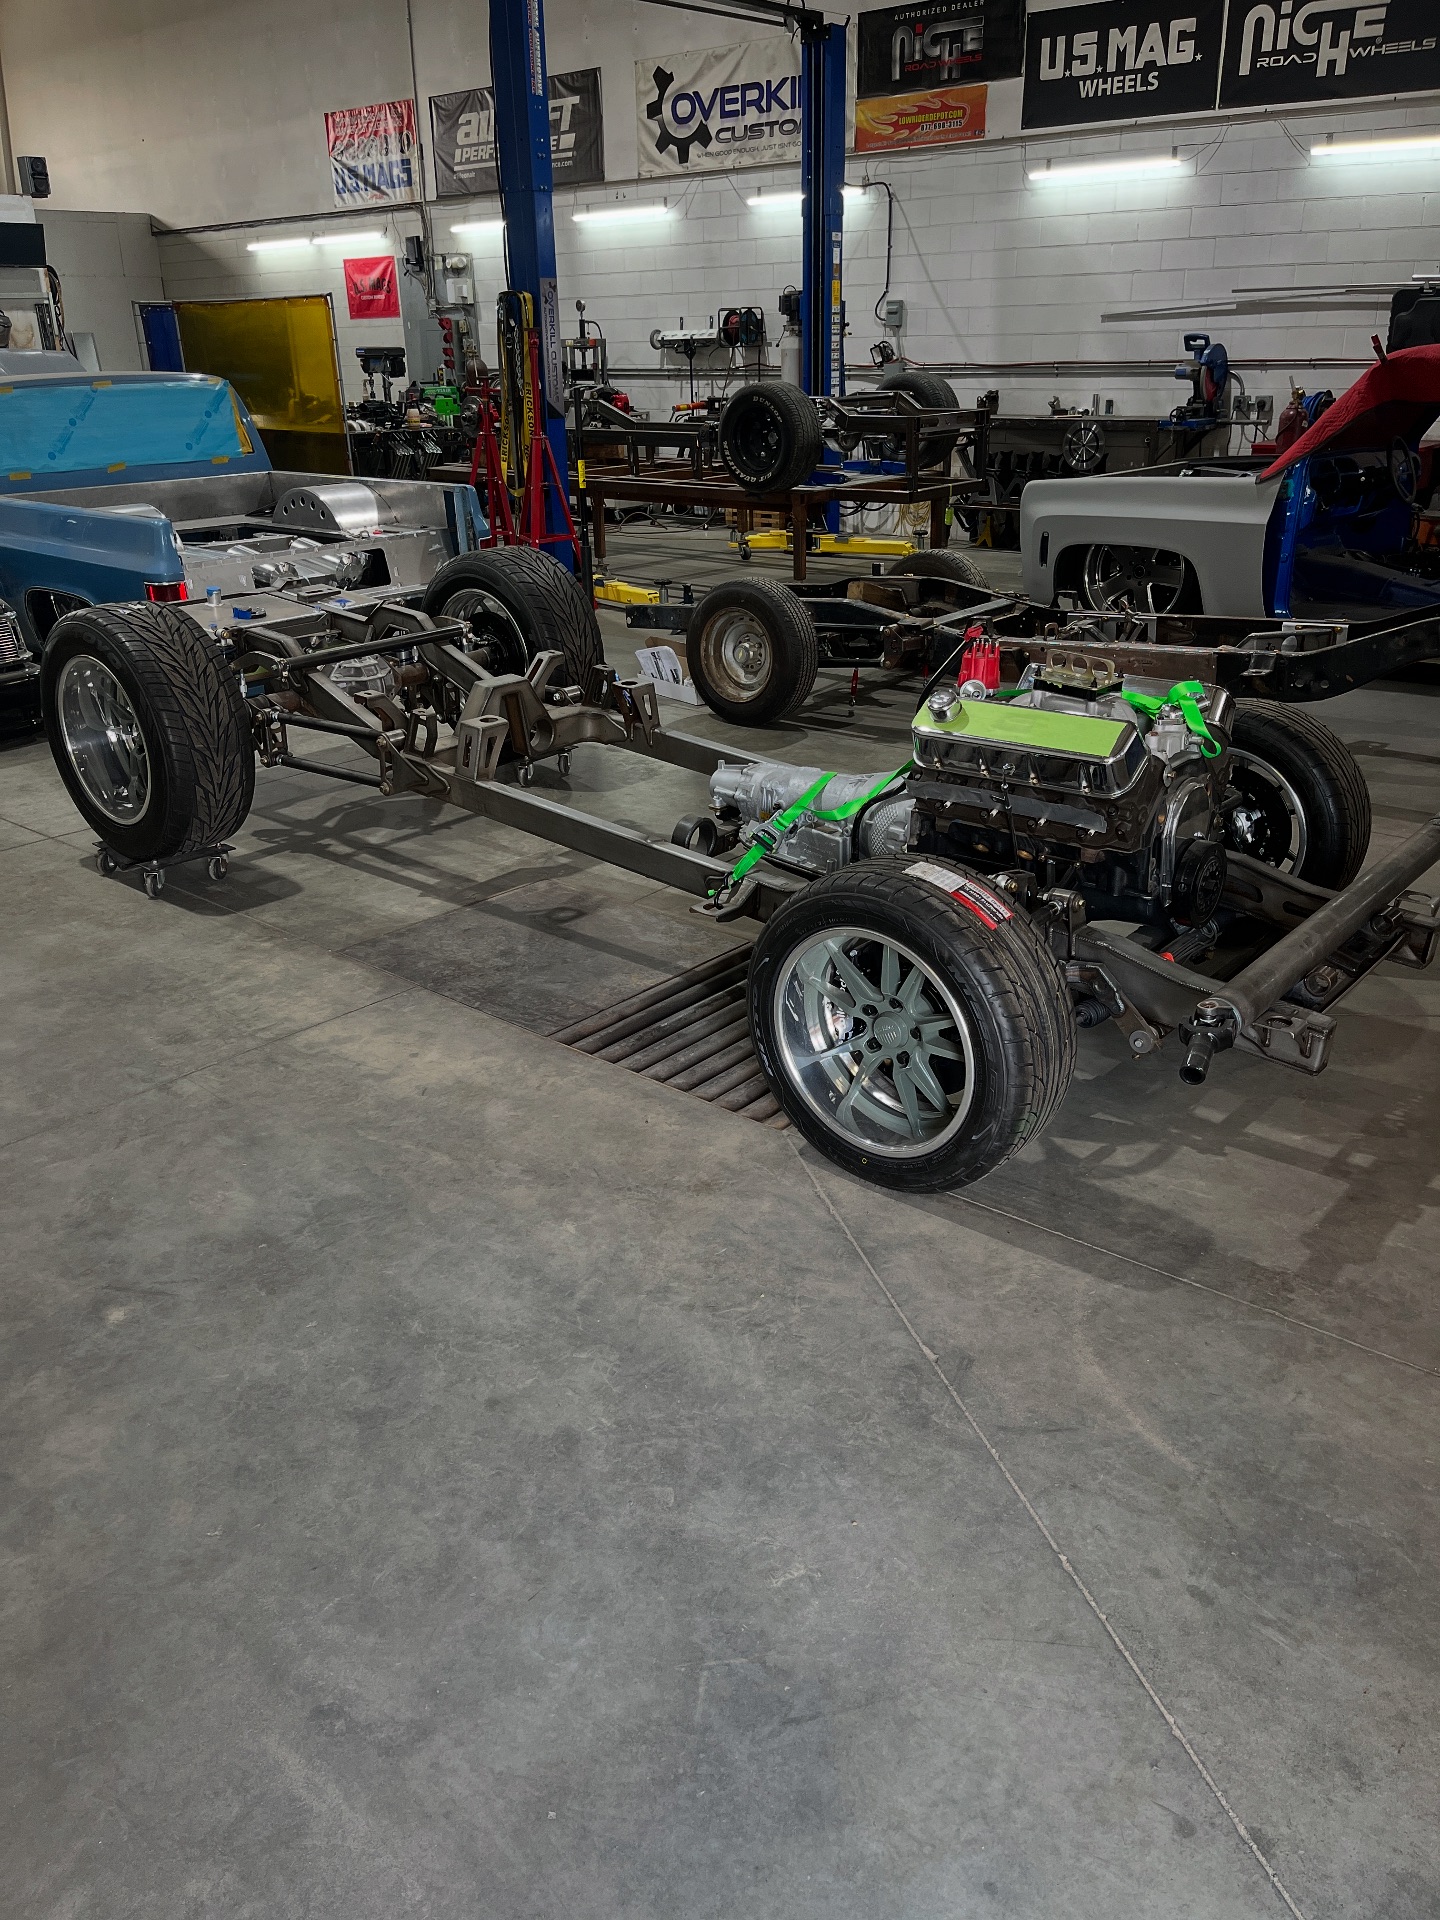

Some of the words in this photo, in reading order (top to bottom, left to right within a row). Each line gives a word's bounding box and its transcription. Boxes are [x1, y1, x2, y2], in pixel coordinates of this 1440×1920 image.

[894, 6, 947, 21] AUTHORIZED
[951, 0, 985, 11] DEALER
[904, 61, 937, 72] ROAD
[1257, 52, 1316, 69] ROAD
[1350, 37, 1437, 58] WHEELS
[1079, 72, 1159, 99] WHEELS
[671, 75, 802, 125] OVERKI
[715, 118, 802, 143] CUSTO
[714, 148, 732, 157] GOOD
[760, 143, 776, 151] JUST
[547, 290, 557, 348] OVERKILL
[550, 351, 559, 403] CUSTOMS
[525, 381, 535, 436] ERICKSON
[752, 396, 782, 423] DUNLOP
